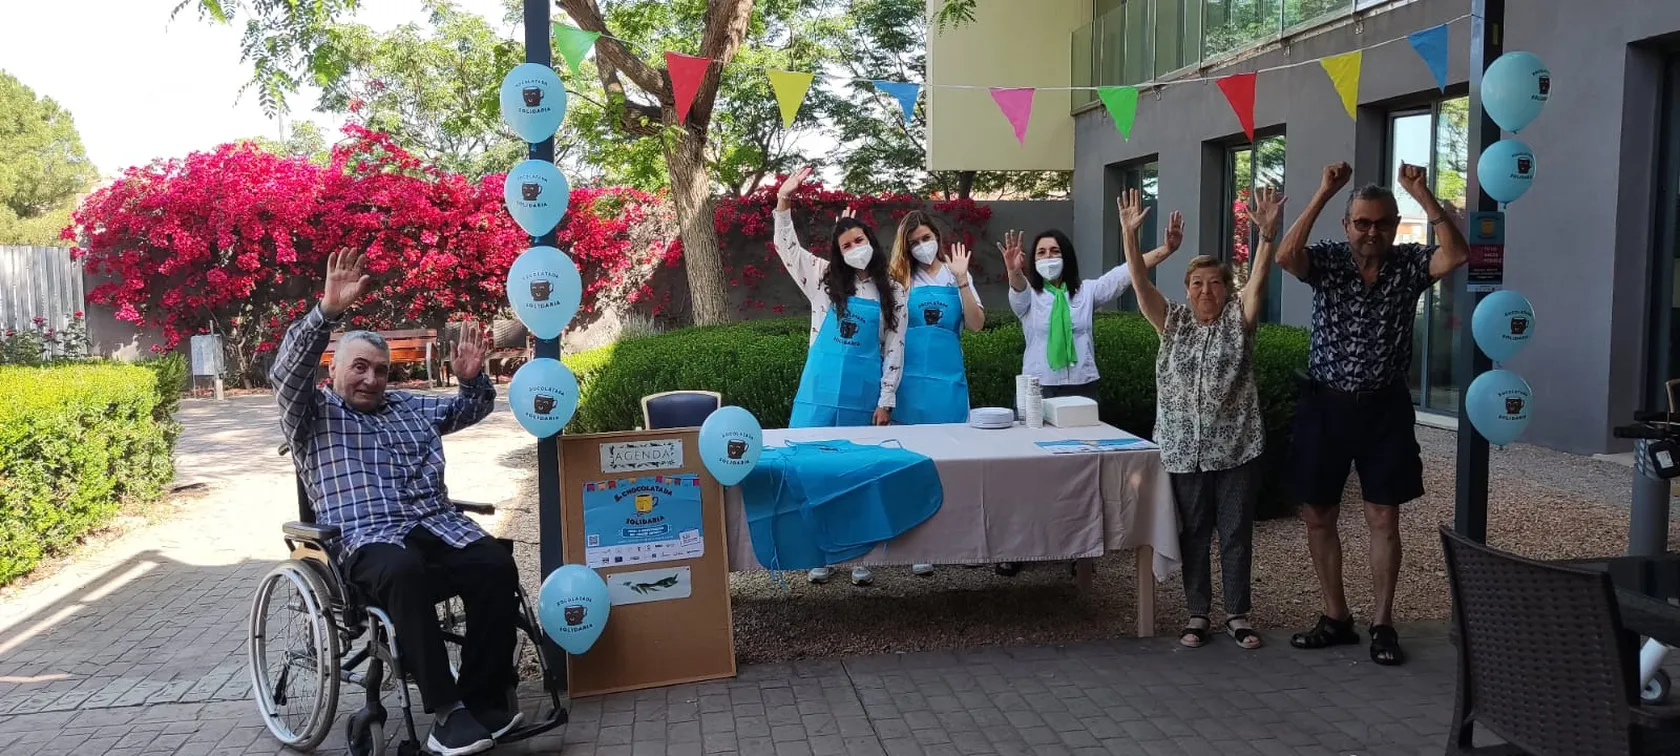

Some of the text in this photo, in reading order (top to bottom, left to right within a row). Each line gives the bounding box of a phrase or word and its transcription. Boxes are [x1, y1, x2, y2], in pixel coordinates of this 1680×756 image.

[615, 449, 671, 462] AGENDA
[621, 485, 673, 497] CHOCOLATADA
[626, 515, 665, 525] SOLIDARIA
